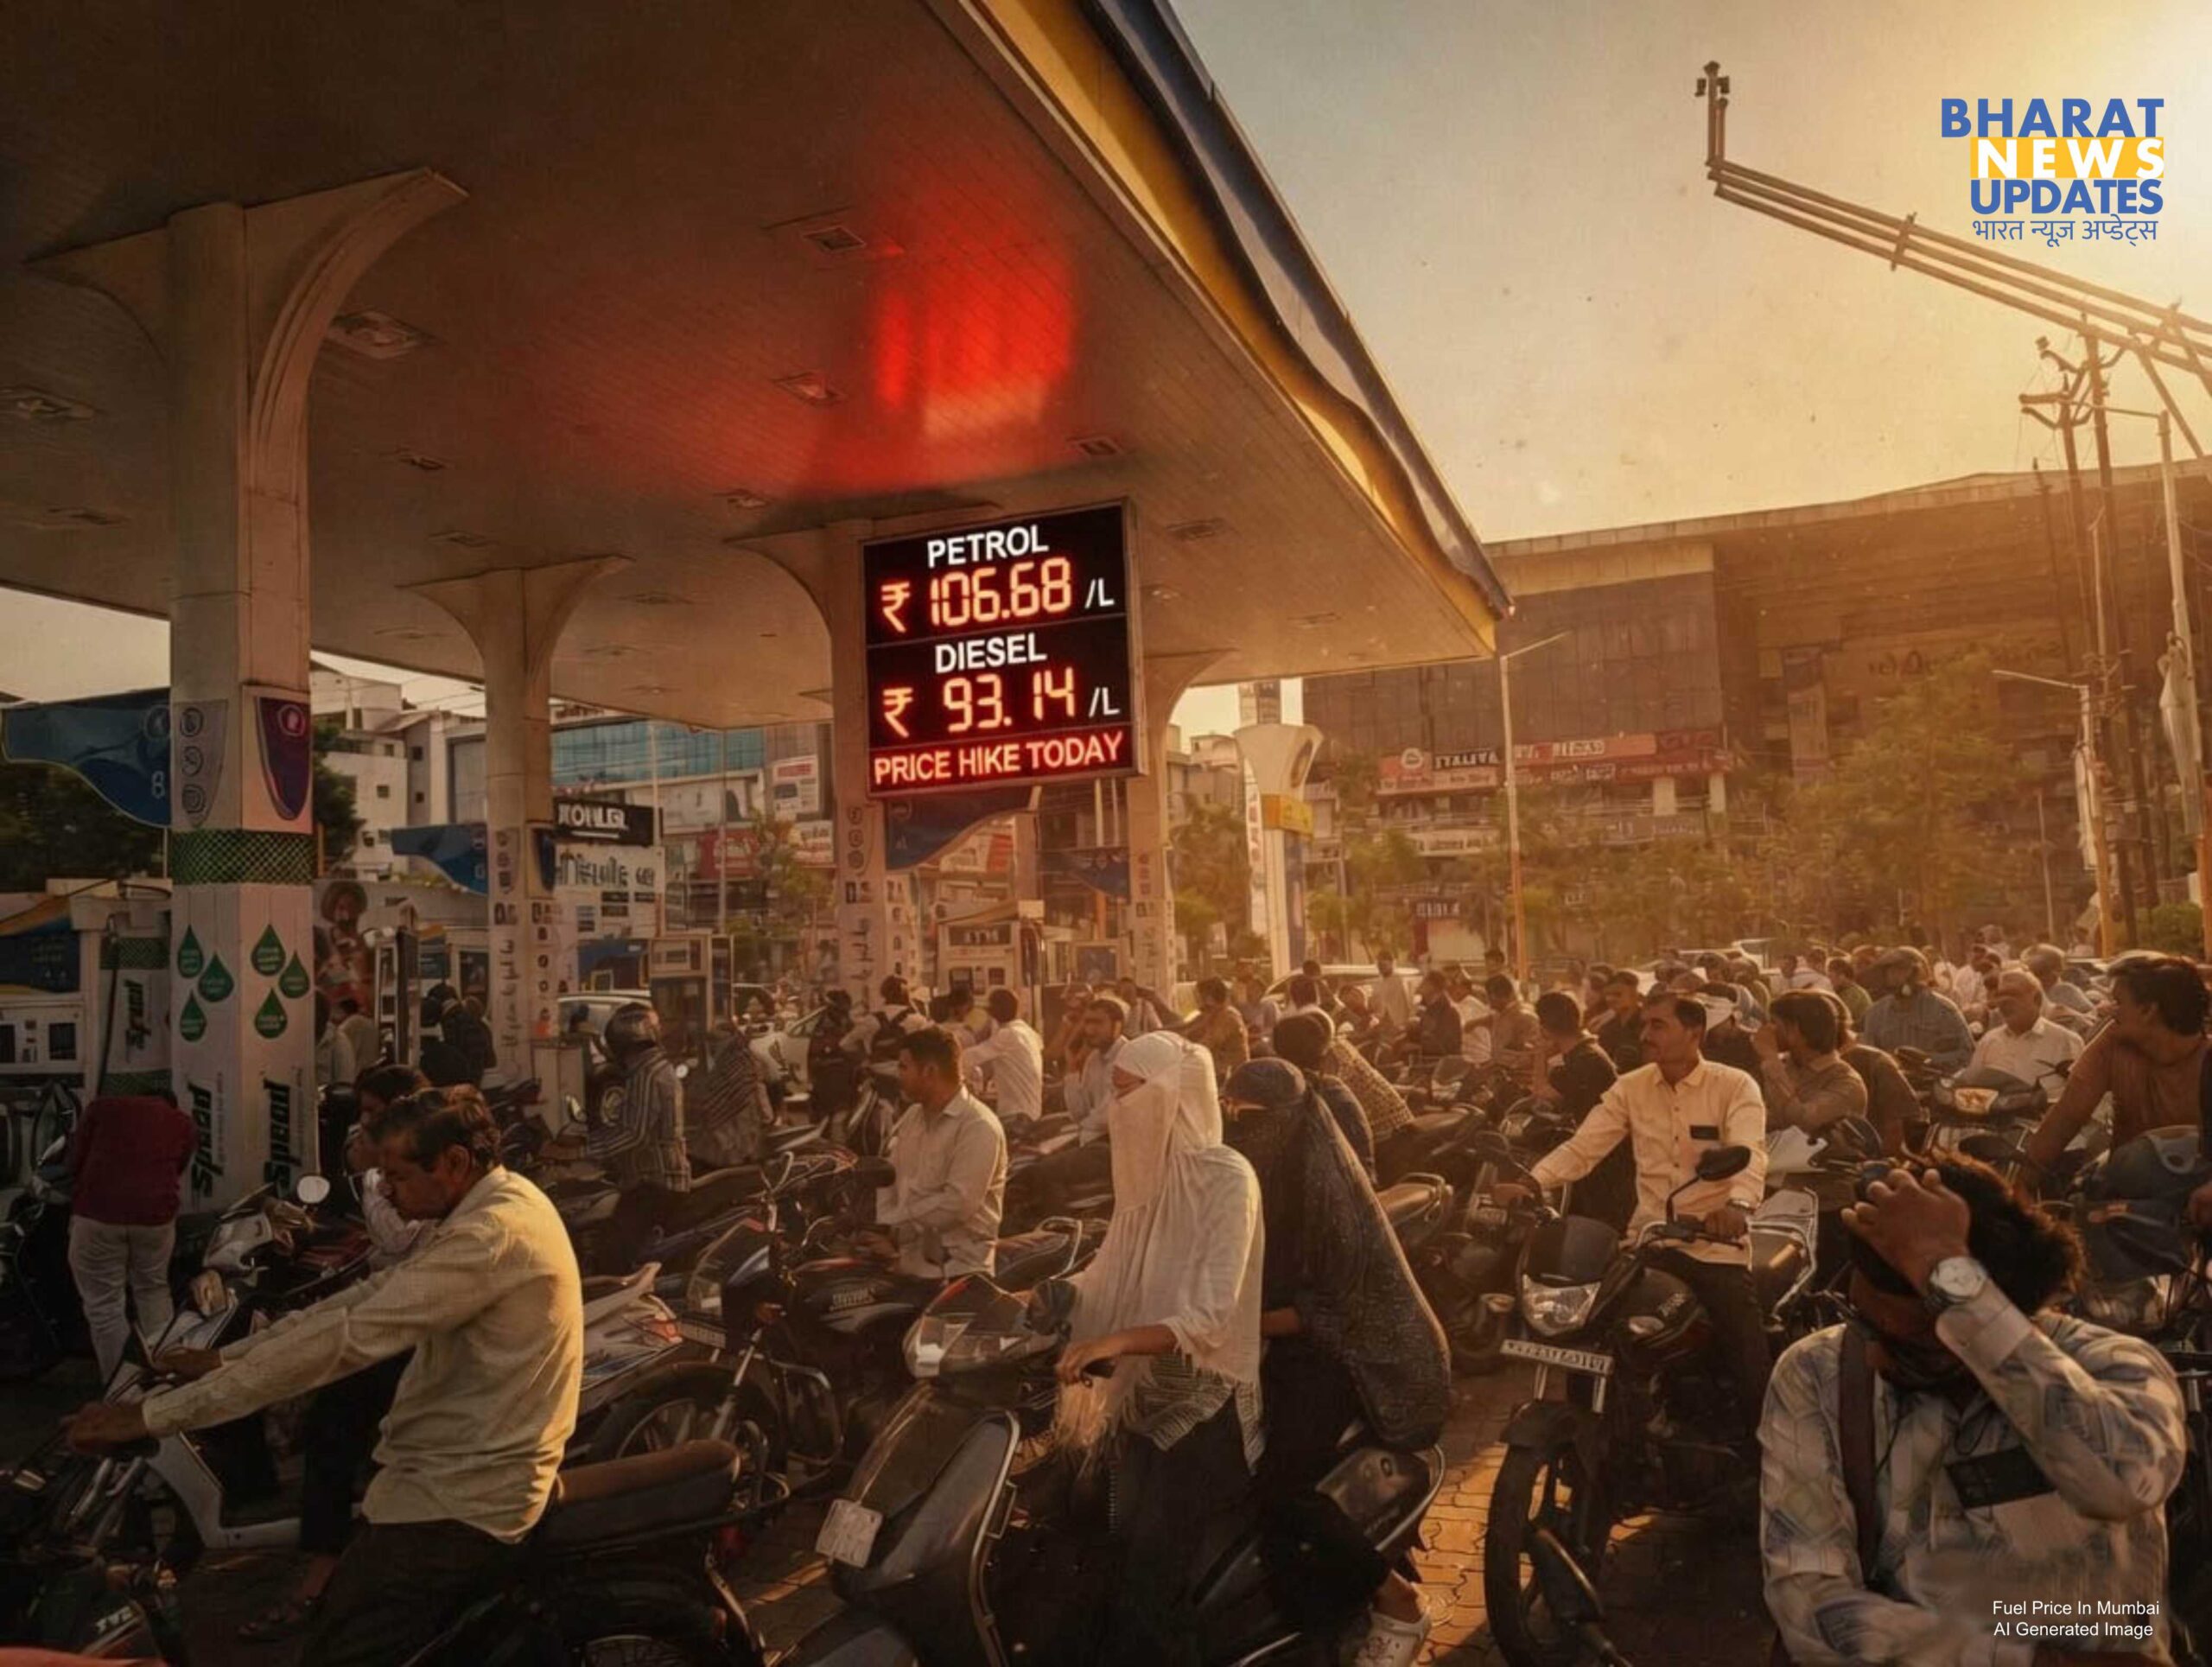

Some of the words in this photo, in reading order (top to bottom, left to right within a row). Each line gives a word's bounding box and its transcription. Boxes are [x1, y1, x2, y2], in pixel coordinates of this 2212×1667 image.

[927, 524, 1050, 569] PETROL
[930, 557, 1072, 627] 106.68
[1084, 577, 1115, 609] /L
[935, 632, 1047, 674] DIESEL
[1089, 686, 1120, 719] /L
[874, 750, 951, 785] PRICE
[958, 743, 1021, 778] HIKE
[1026, 730, 1123, 769] TODAY
